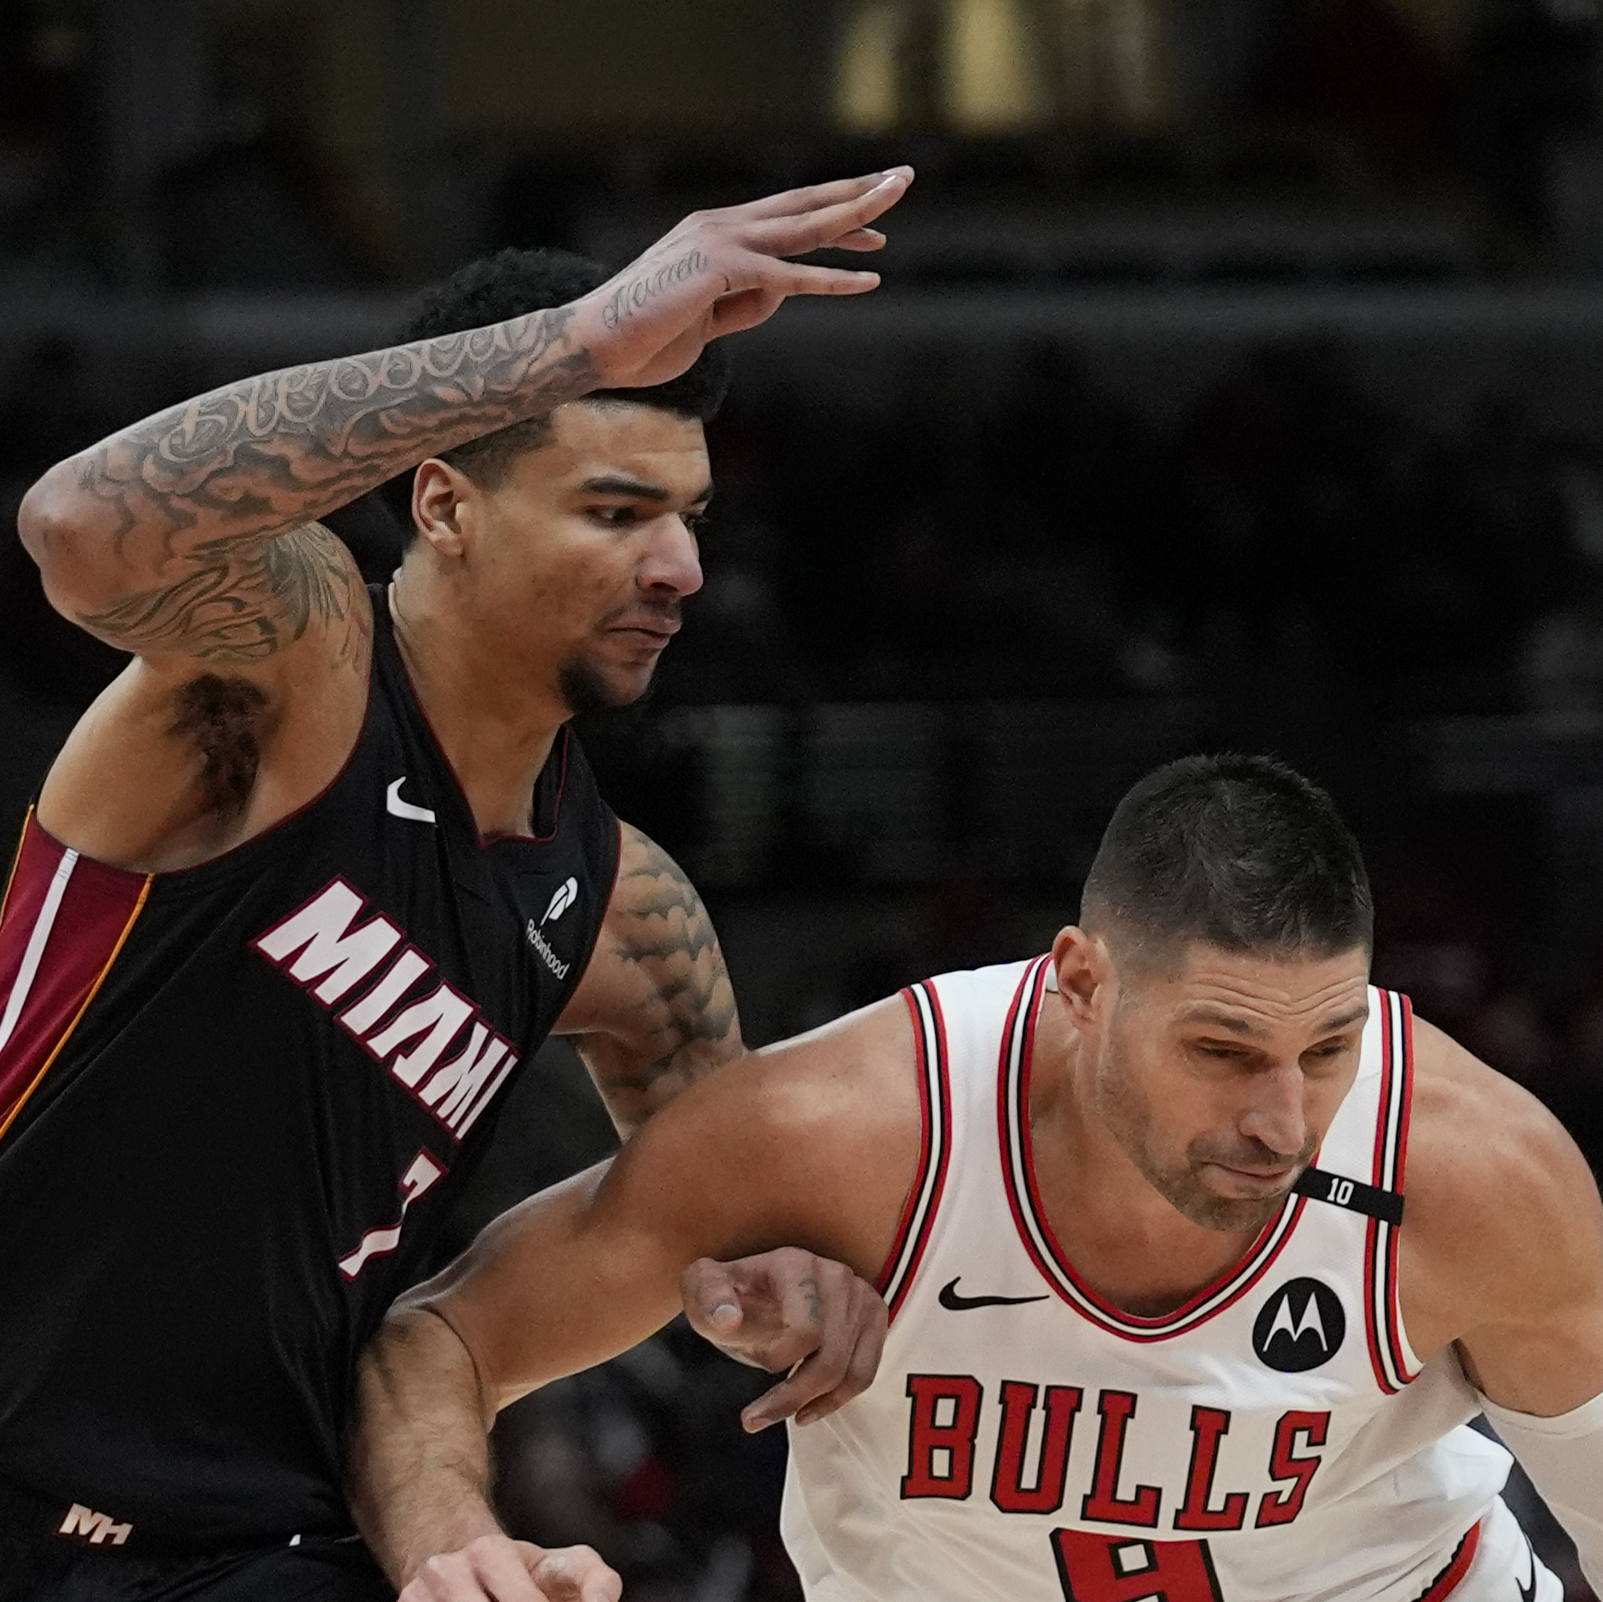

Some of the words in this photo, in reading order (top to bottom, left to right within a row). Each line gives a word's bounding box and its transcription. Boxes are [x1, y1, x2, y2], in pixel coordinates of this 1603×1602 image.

[526, 918, 570, 980] Robinhood
[250, 875, 522, 1142] MIAMI
[1326, 1177, 1355, 1206] 10
[899, 1373, 1332, 1532] BULLS
